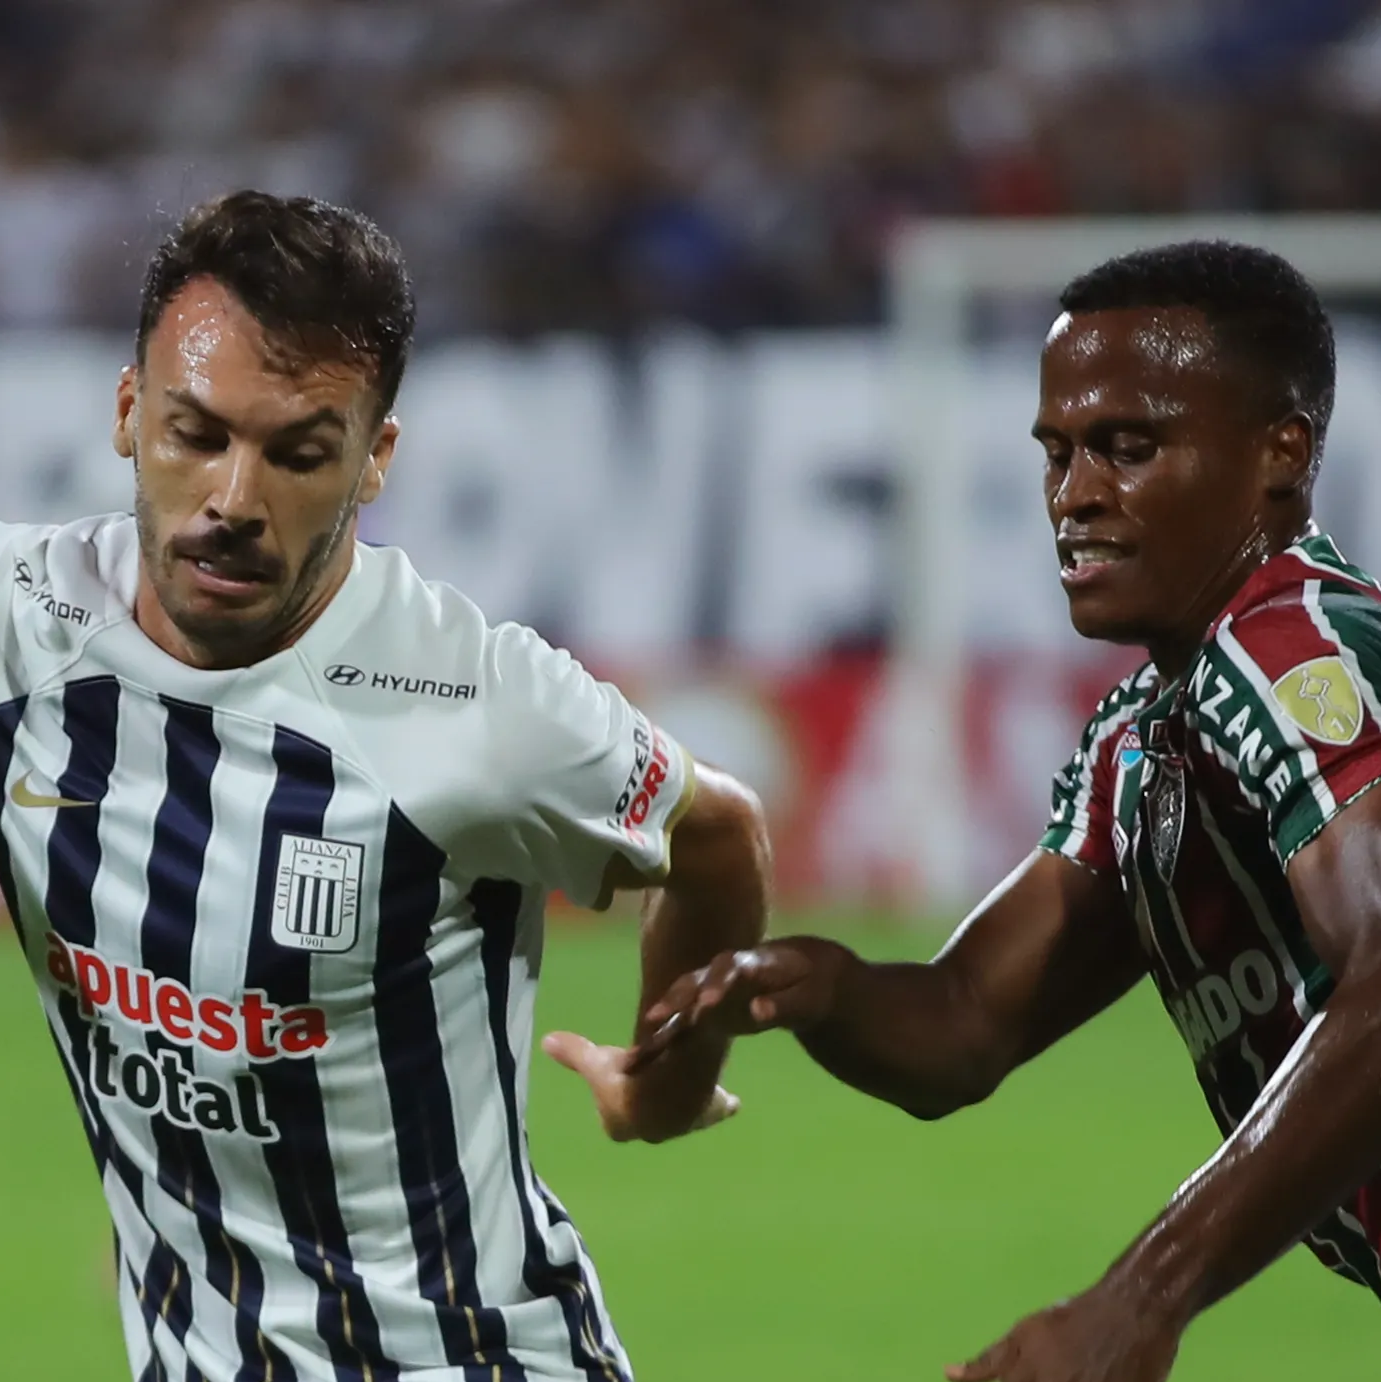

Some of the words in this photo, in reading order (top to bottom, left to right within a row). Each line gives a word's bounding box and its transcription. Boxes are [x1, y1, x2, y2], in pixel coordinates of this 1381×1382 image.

[371, 672, 477, 700] HYUNDAI
[1186, 649, 1292, 803] NZANE
[290, 839, 352, 859] ALIANZA
[276, 865, 291, 910] CLUB
[343, 876, 357, 918] LIMA
[299, 936, 324, 948] 1901
[45, 931, 332, 1060] apuesta
[90, 1022, 278, 1140] total
